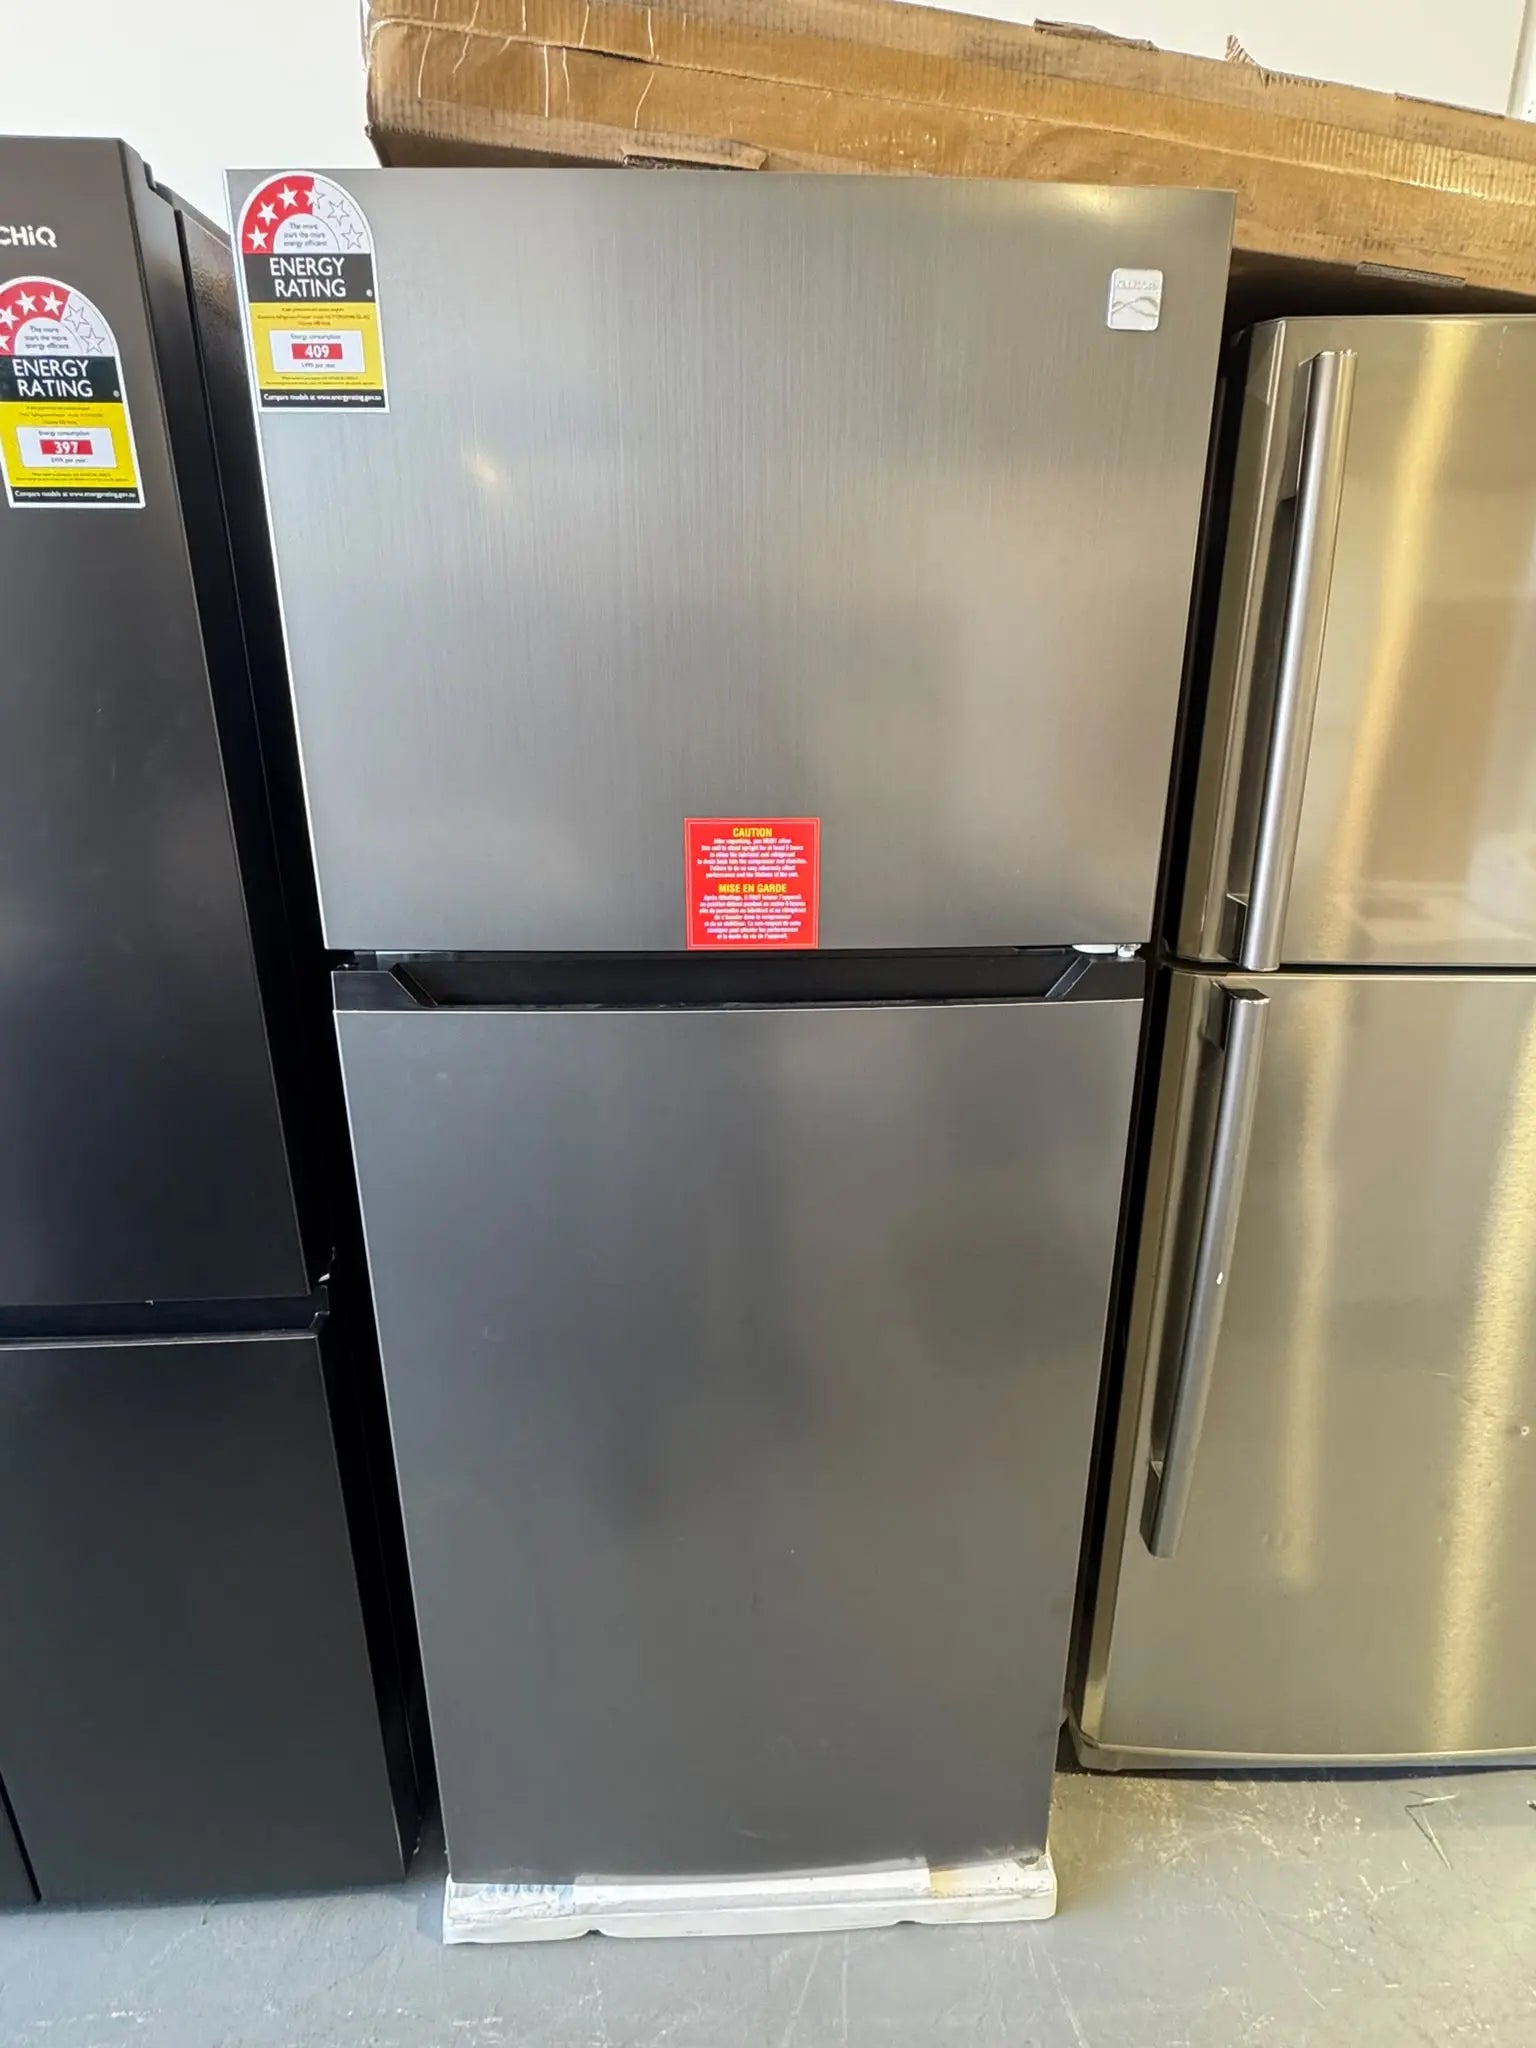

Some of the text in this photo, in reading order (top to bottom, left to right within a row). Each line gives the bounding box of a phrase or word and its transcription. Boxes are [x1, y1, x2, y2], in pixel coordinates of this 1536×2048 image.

[0, 225, 58, 248] CHiQ
[269, 257, 345, 276] ENERGY
[274, 279, 346, 298] RATING
[304, 344, 330, 358] 409
[12, 359, 89, 377] ENERGY
[17, 379, 94, 397] RATING
[54, 441, 79, 454] 397
[732, 827, 772, 837] CAUTION
[718, 883, 787, 893] MISE EN GARDE
